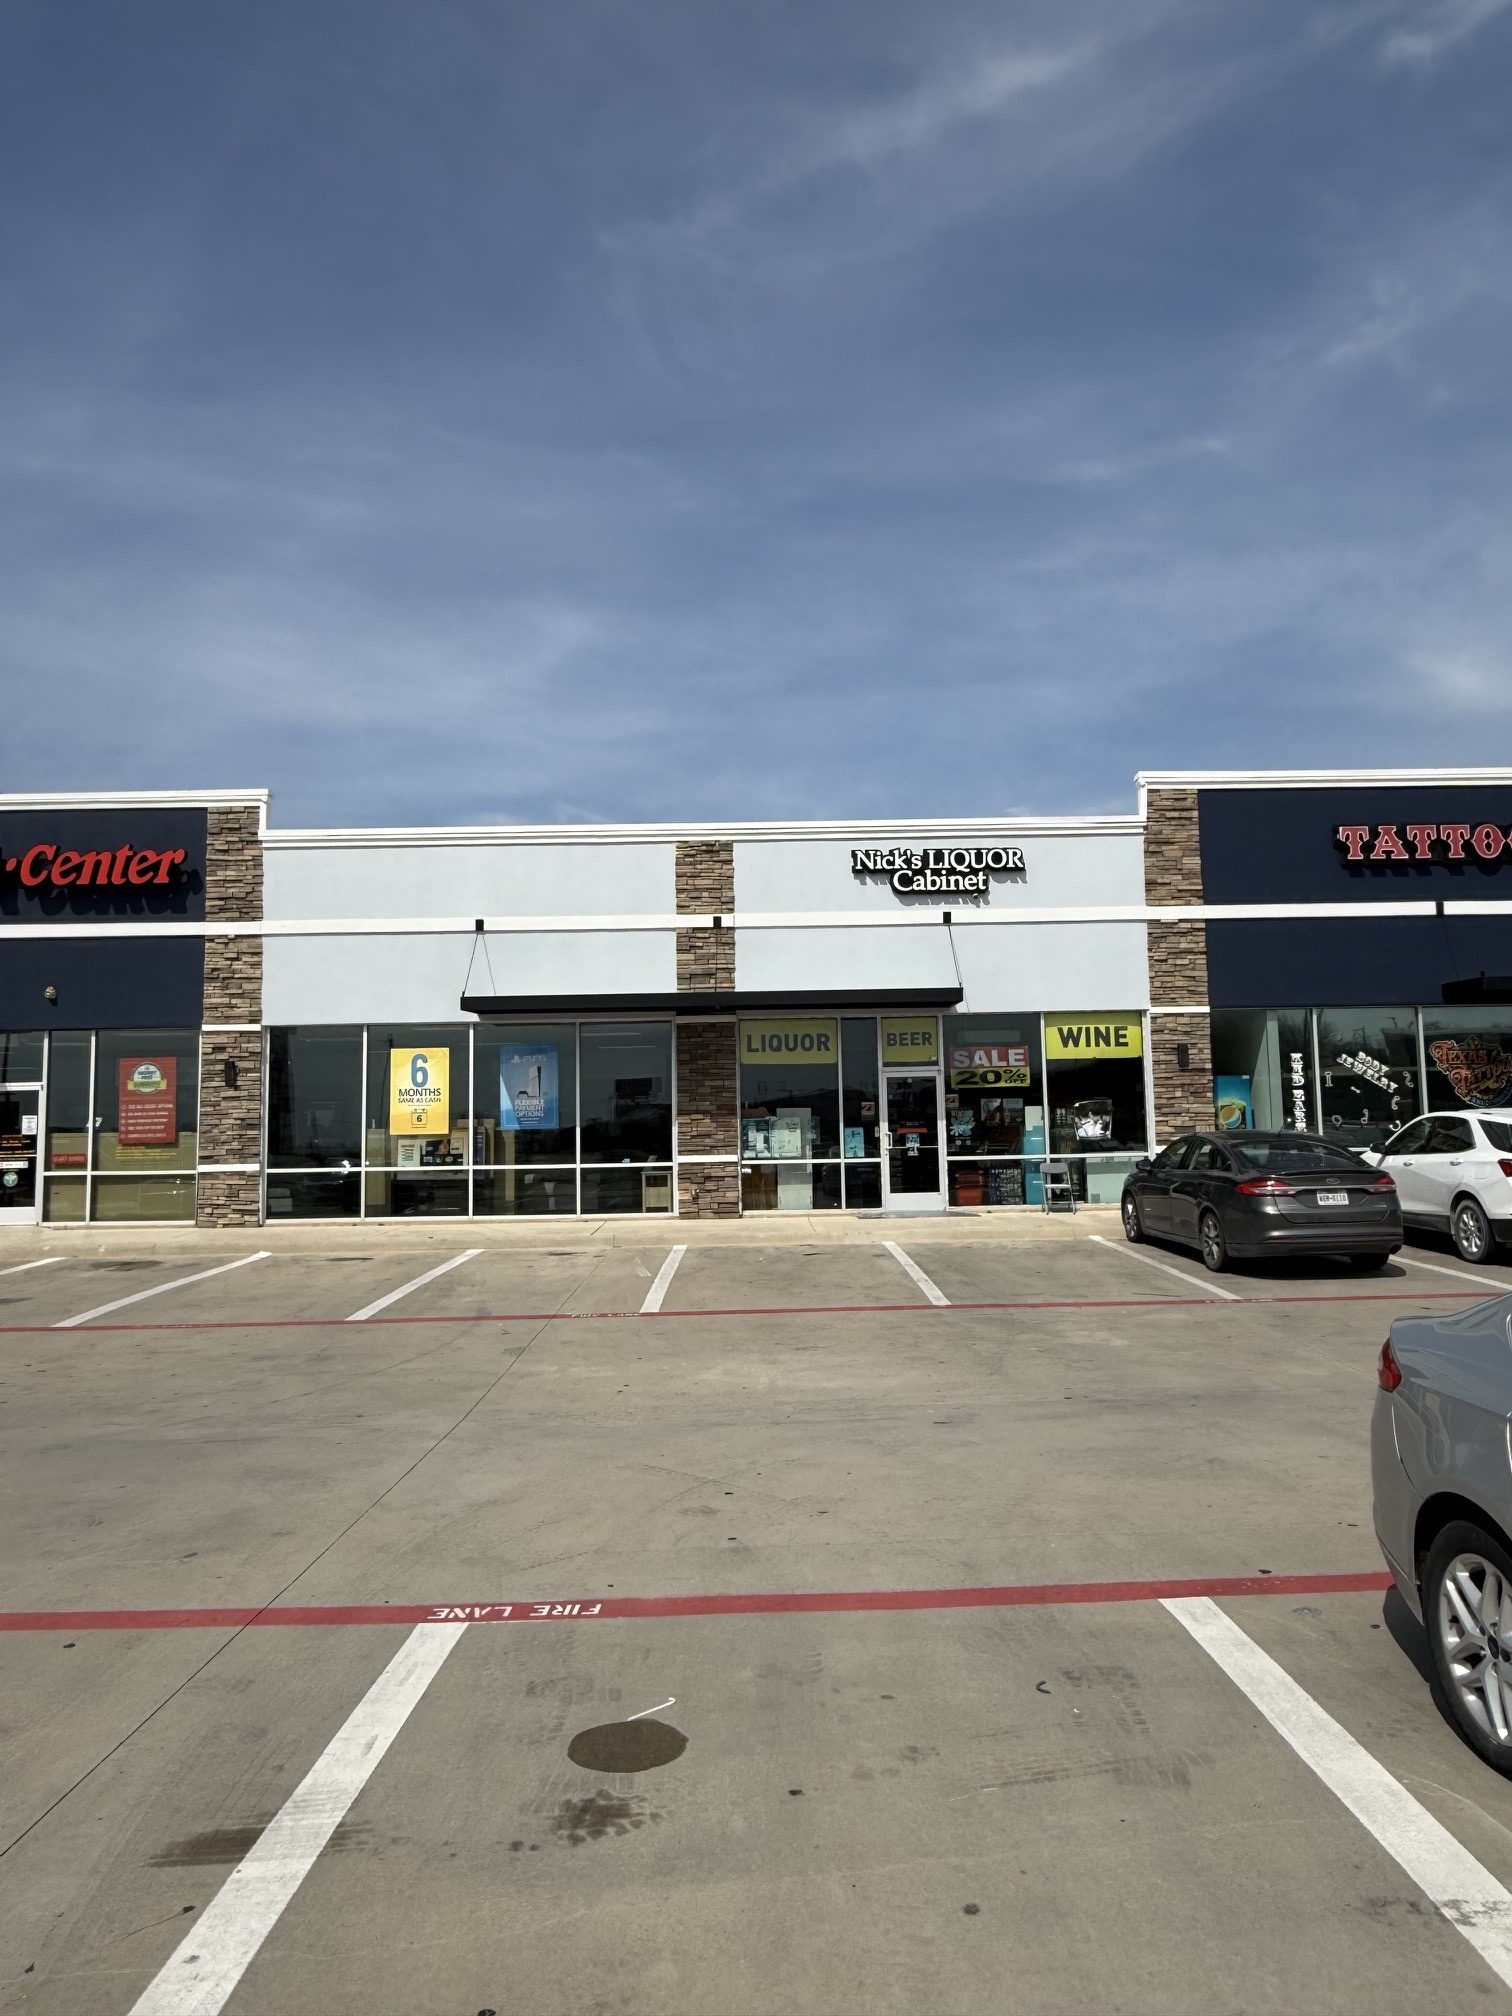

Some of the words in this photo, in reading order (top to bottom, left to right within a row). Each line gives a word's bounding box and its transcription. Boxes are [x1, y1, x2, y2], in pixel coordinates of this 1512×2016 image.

[1338, 824, 1512, 859] TATTO
[855, 849, 922, 870] Nick's
[926, 849, 1024, 872] LIQUOR
[893, 869, 987, 892] Cabinet
[746, 1033, 831, 1053] LIQUOR
[886, 1031, 933, 1047] BEER
[1057, 1025, 1129, 1048] WINE
[953, 1048, 1026, 1068] SALE
[1355, 1051, 1390, 1076] BODY
[1430, 1041, 1488, 1069] TEXAS
[411, 1053, 429, 1088] 6
[954, 1068, 1027, 1086] 20%
[398, 1088, 441, 1097] MONTHS
[416, 1114, 423, 1123] 6
[427, 1606, 513, 1619] LANE
[530, 1604, 602, 1617] FIRE
